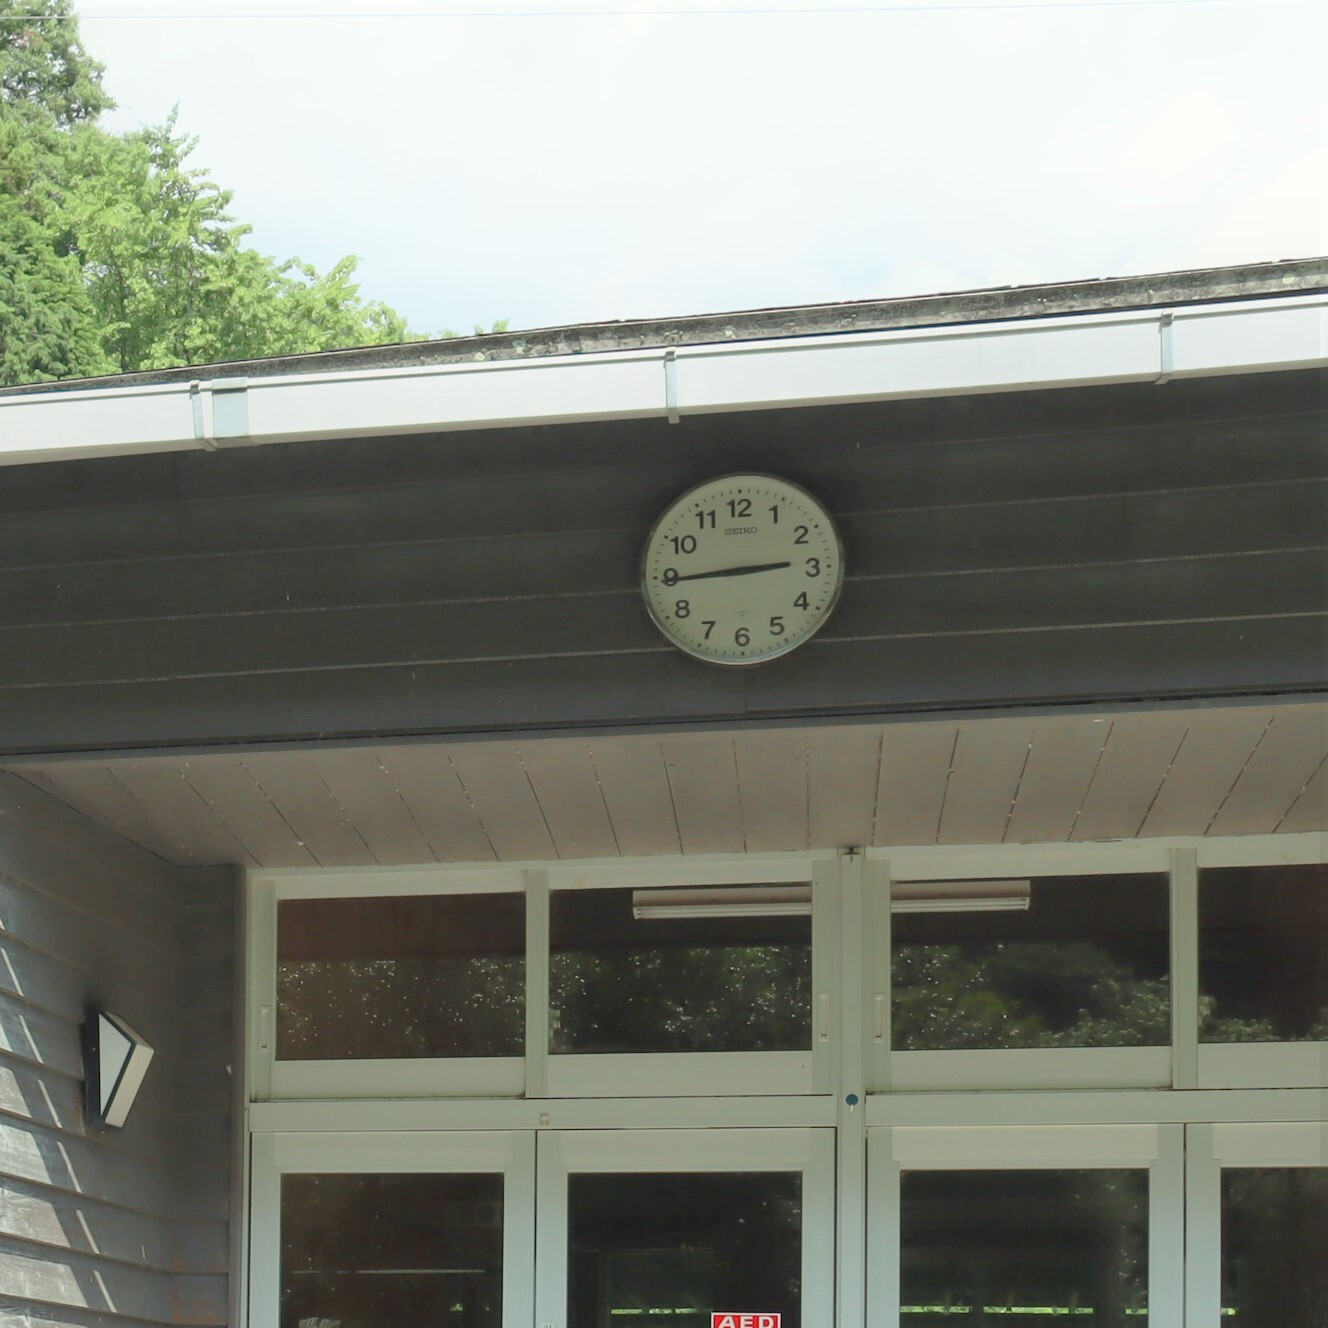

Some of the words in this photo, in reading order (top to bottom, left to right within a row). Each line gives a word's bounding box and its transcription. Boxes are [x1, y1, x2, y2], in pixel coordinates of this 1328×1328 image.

[726, 498, 752, 518] 12
[769, 505, 778, 524] 1
[695, 510, 717, 529] 11
[724, 526, 758, 536] SEIKO
[794, 525, 809, 545] 2
[670, 535, 697, 555] 10
[663, 567, 679, 587] 9
[805, 557, 821, 578] 3
[674, 600, 690, 618] 8
[793, 591, 809, 611] 4
[701, 620, 716, 640] 7
[769, 616, 785, 635] 5
[734, 627, 750, 646] 6
